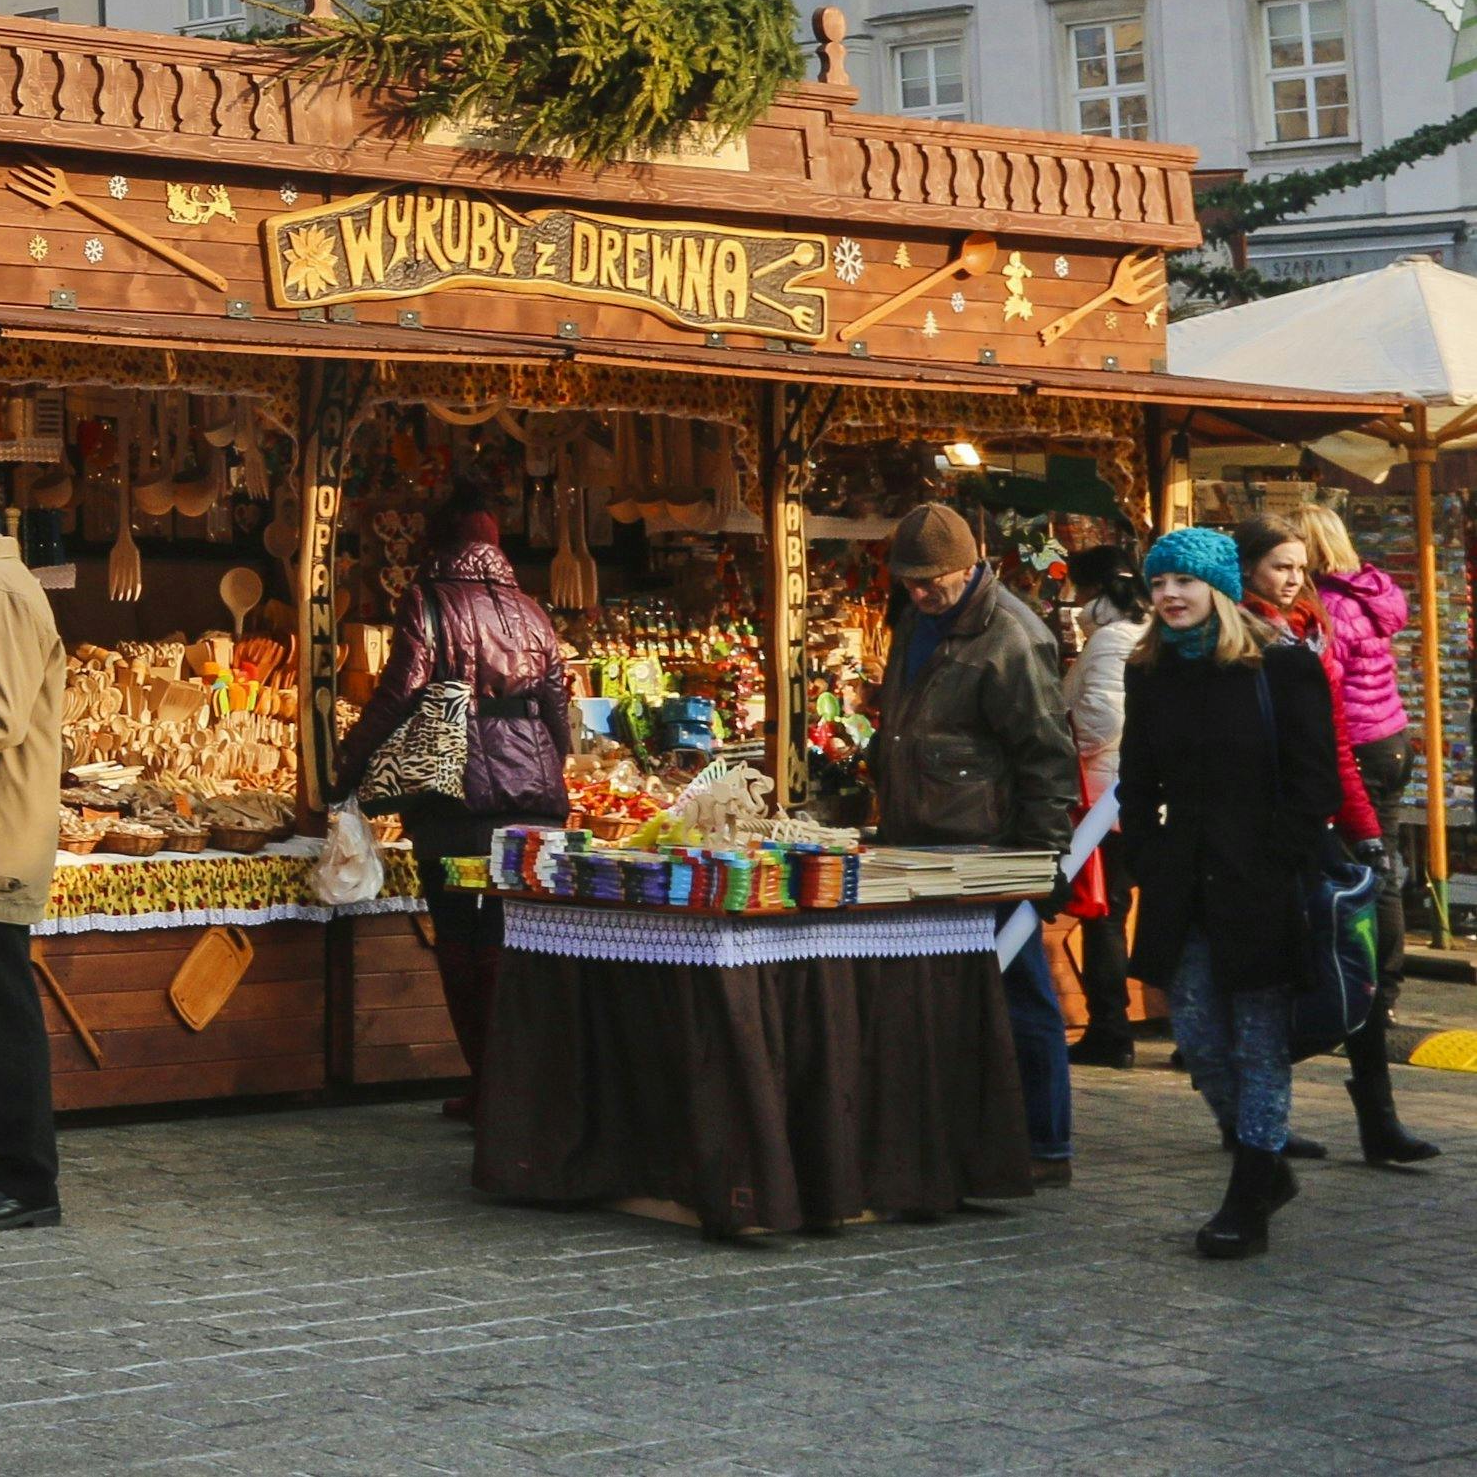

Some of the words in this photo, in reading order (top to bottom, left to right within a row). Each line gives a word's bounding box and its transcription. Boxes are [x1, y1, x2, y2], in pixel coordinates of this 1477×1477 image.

[339, 187, 519, 286] WYROBY
[571, 221, 748, 319] DREWNA
[312, 372, 346, 676] ZAKOPANE
[785, 464, 804, 713] ZABAWKI
